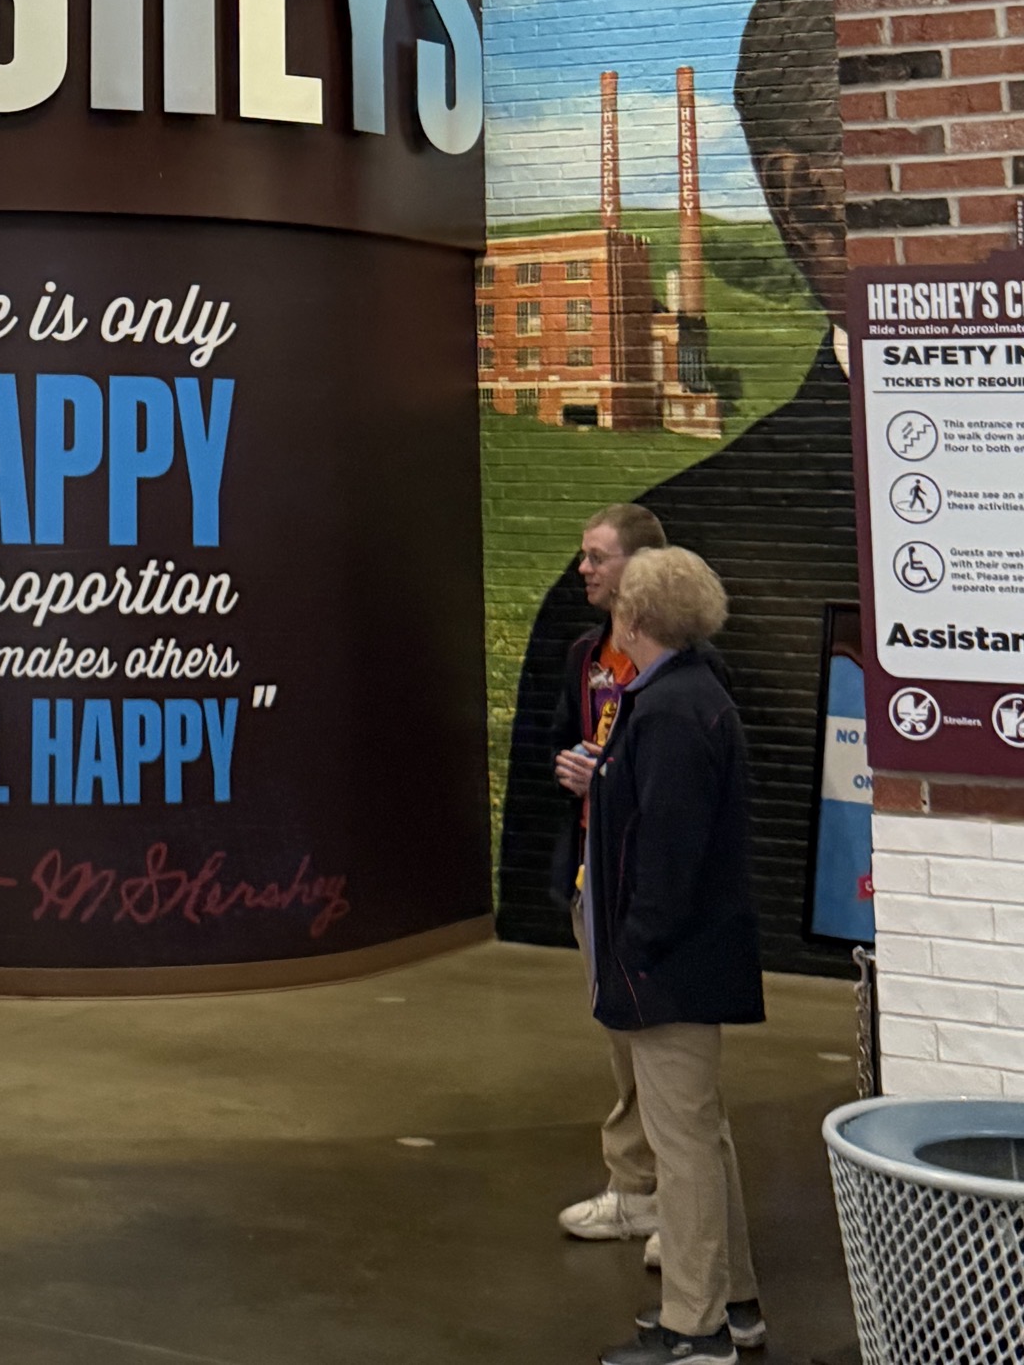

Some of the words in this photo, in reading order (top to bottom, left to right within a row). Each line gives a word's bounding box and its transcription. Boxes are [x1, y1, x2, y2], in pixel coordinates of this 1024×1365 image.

[680, 106, 694, 216] HERSHEY
[867, 281, 999, 320] HERSHEY'S
[28, 281, 88, 341] is
[101, 284, 237, 368] only
[869, 325, 895, 335] Ride
[898, 324, 948, 335] Duration
[883, 345, 997, 366] SAFETY
[882, 377, 941, 388] TICKETS
[944, 377, 974, 388] NOT
[943, 420, 964, 428] This
[967, 420, 1013, 429] entrance
[944, 432, 955, 440] to
[958, 432, 982, 441] walk
[984, 432, 1014, 441] down
[944, 444, 969, 452] floor
[972, 444, 983, 452] to
[986, 444, 1011, 452] both
[947, 490, 980, 499] Please
[947, 502, 975, 510] these
[950, 560, 973, 568] with
[975, 560, 999, 569] their
[976, 572, 1009, 581] Please
[952, 584, 995, 593] separate
[124, 638, 240, 679] others
[836, 729, 860, 744] NO
